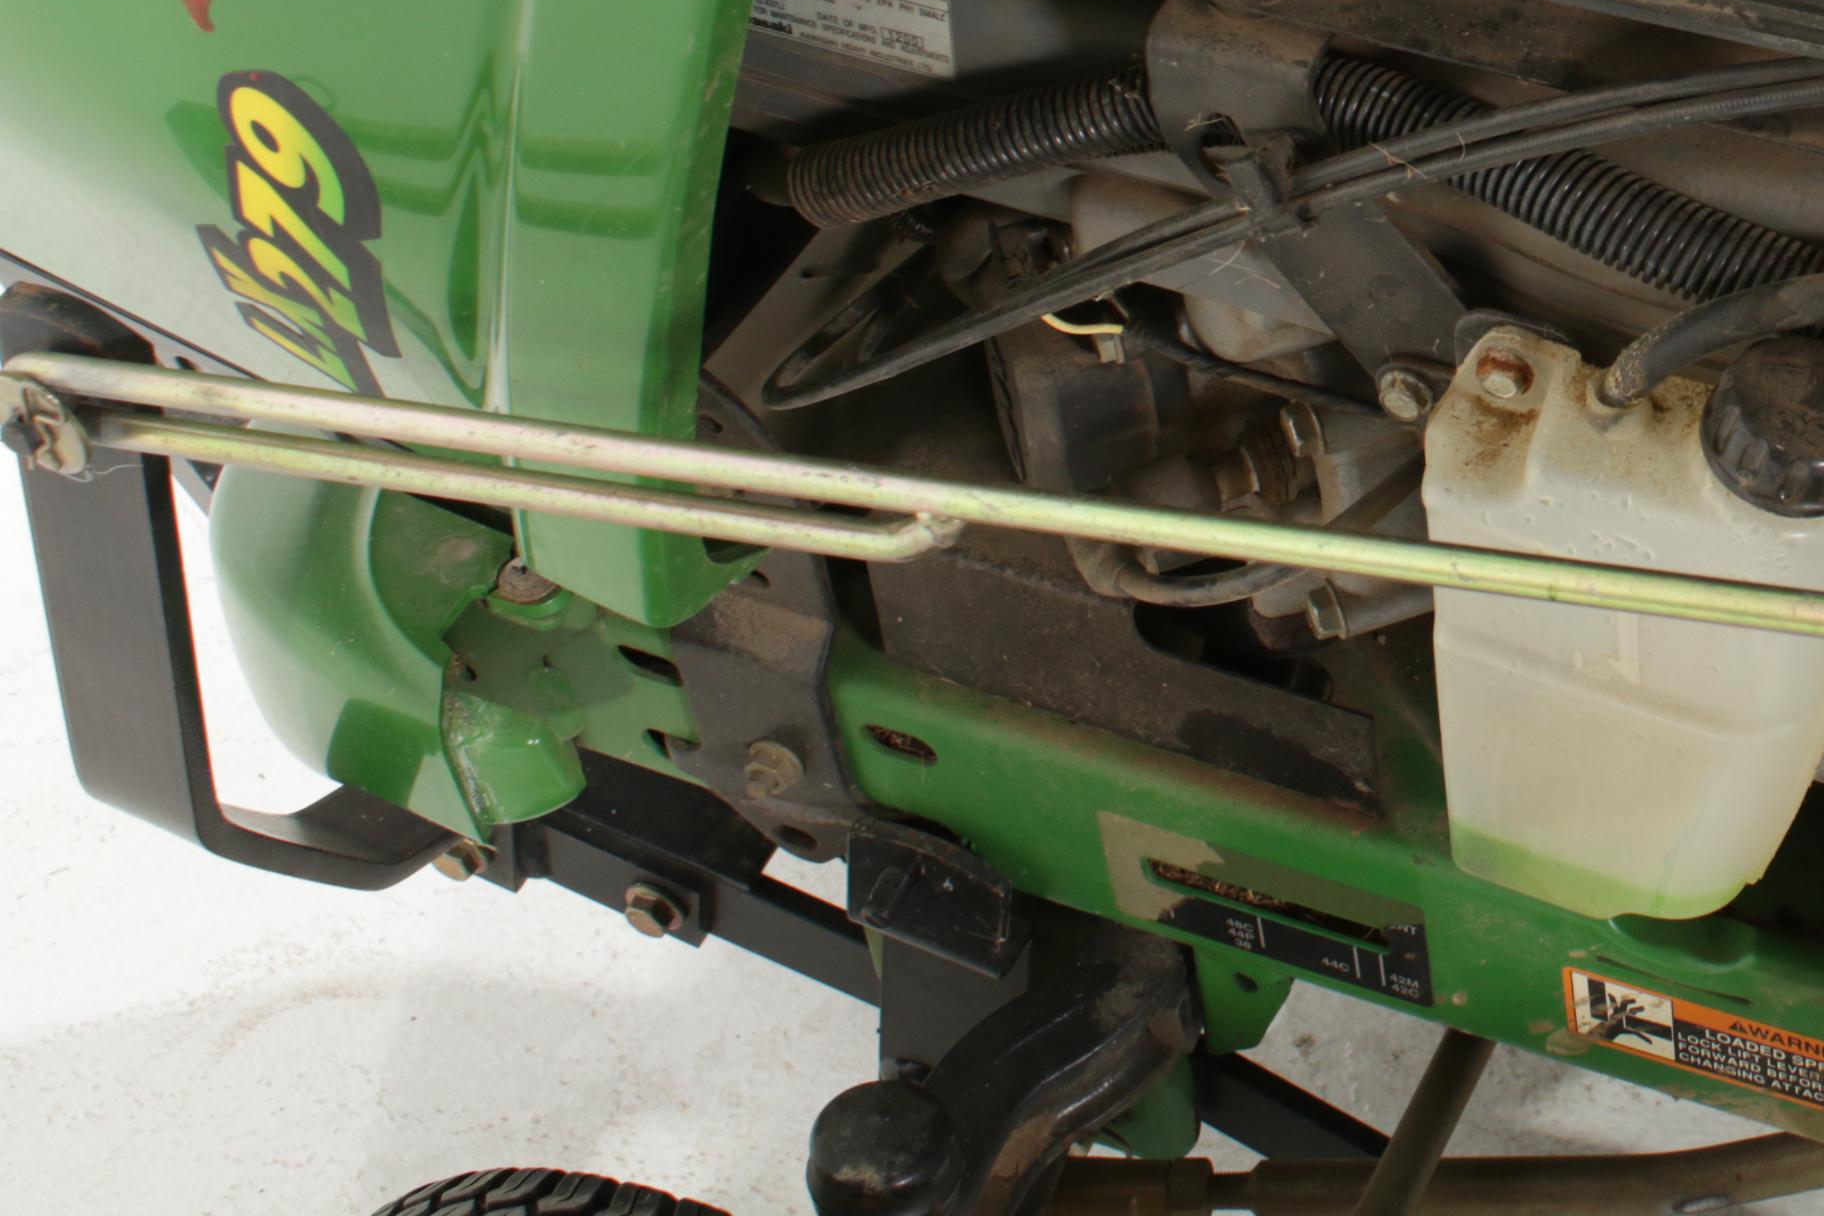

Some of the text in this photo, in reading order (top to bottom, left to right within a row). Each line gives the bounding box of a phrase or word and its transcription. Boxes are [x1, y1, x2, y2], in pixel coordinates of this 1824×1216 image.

[1677, 1032, 1821, 1080] LOCK LIFT LEVER
[1678, 1042, 1761, 1073] FORWARD
[1704, 1028, 1785, 1061] LOADED
[1679, 1052, 1766, 1084] CHANGING
